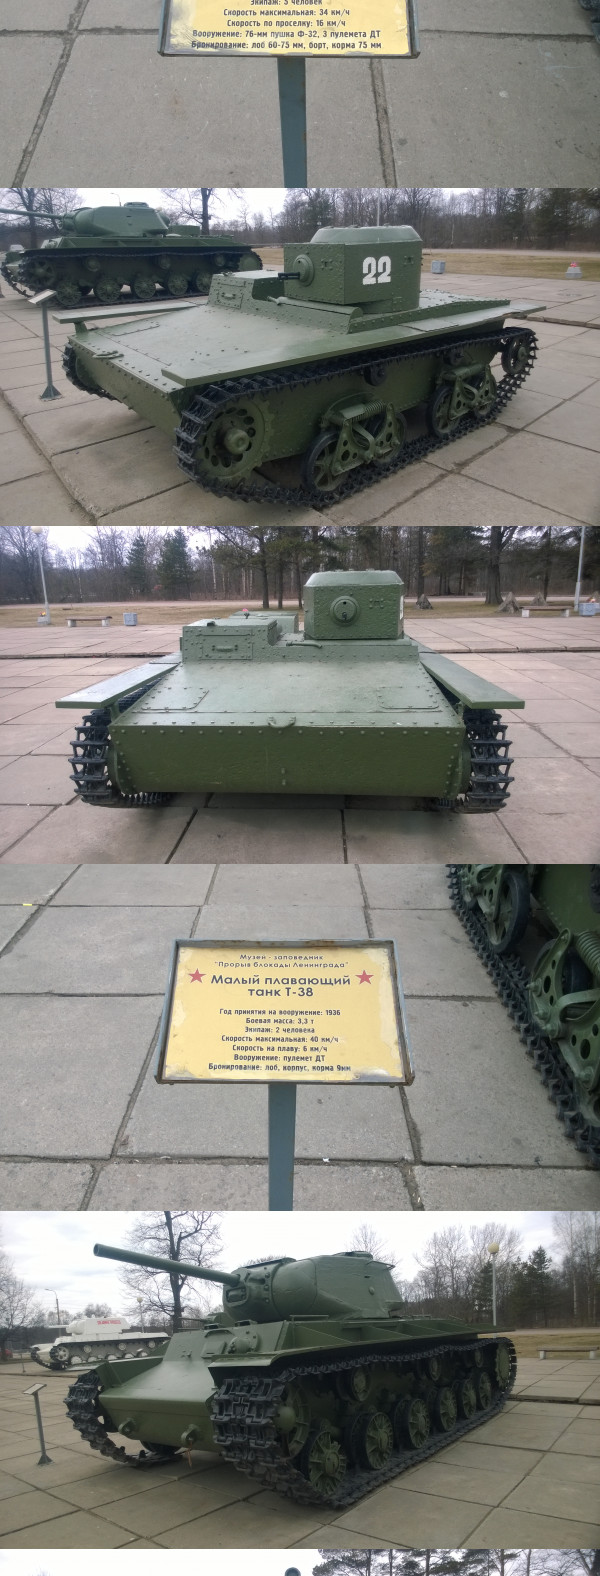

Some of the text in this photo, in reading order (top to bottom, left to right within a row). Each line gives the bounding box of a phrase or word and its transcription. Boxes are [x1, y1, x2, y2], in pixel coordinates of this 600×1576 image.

[193, 30, 242, 38] Вооружение:
[370, 30, 381, 39] ДТ
[362, 256, 392, 285] 22
[211, 975, 350, 986] Малый плавающий
[285, 987, 313, 997] Т-38
